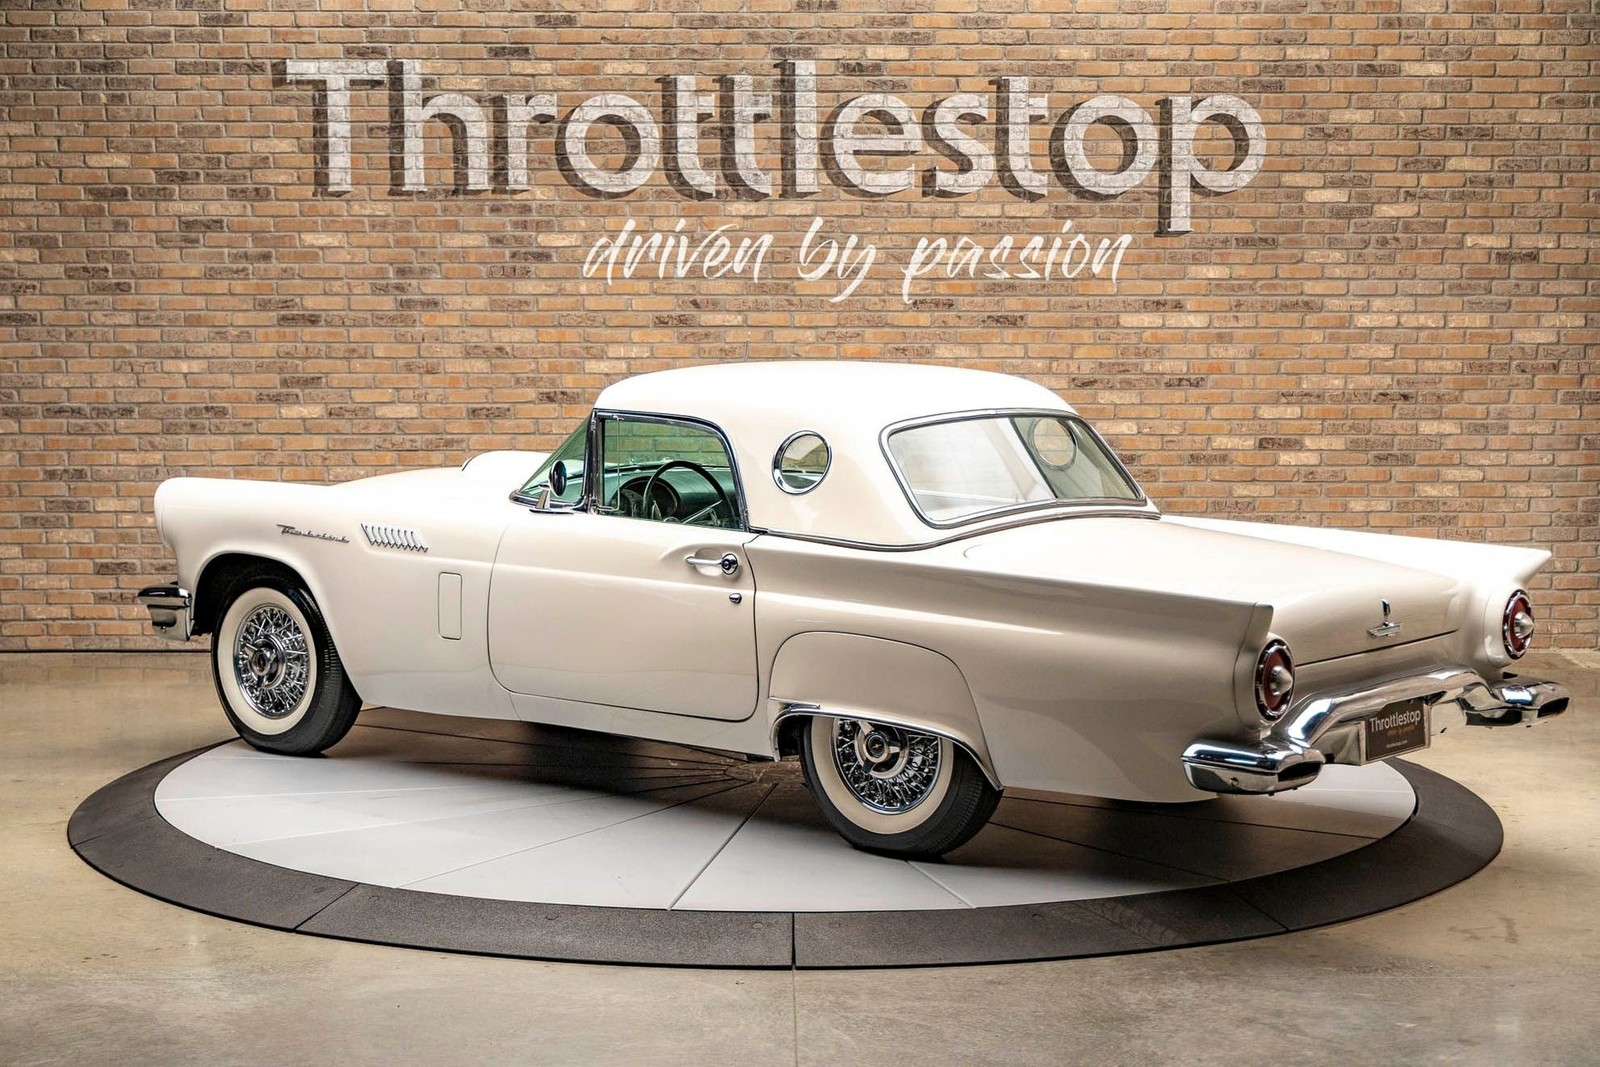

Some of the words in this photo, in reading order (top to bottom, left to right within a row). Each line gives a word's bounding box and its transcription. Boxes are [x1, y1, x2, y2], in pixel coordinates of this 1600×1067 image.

[274, 59, 1266, 235] Throttlestop
[583, 218, 773, 286] driven
[798, 217, 877, 302] by
[901, 220, 1133, 304] passion
[1369, 710, 1421, 732] Throttlestop
